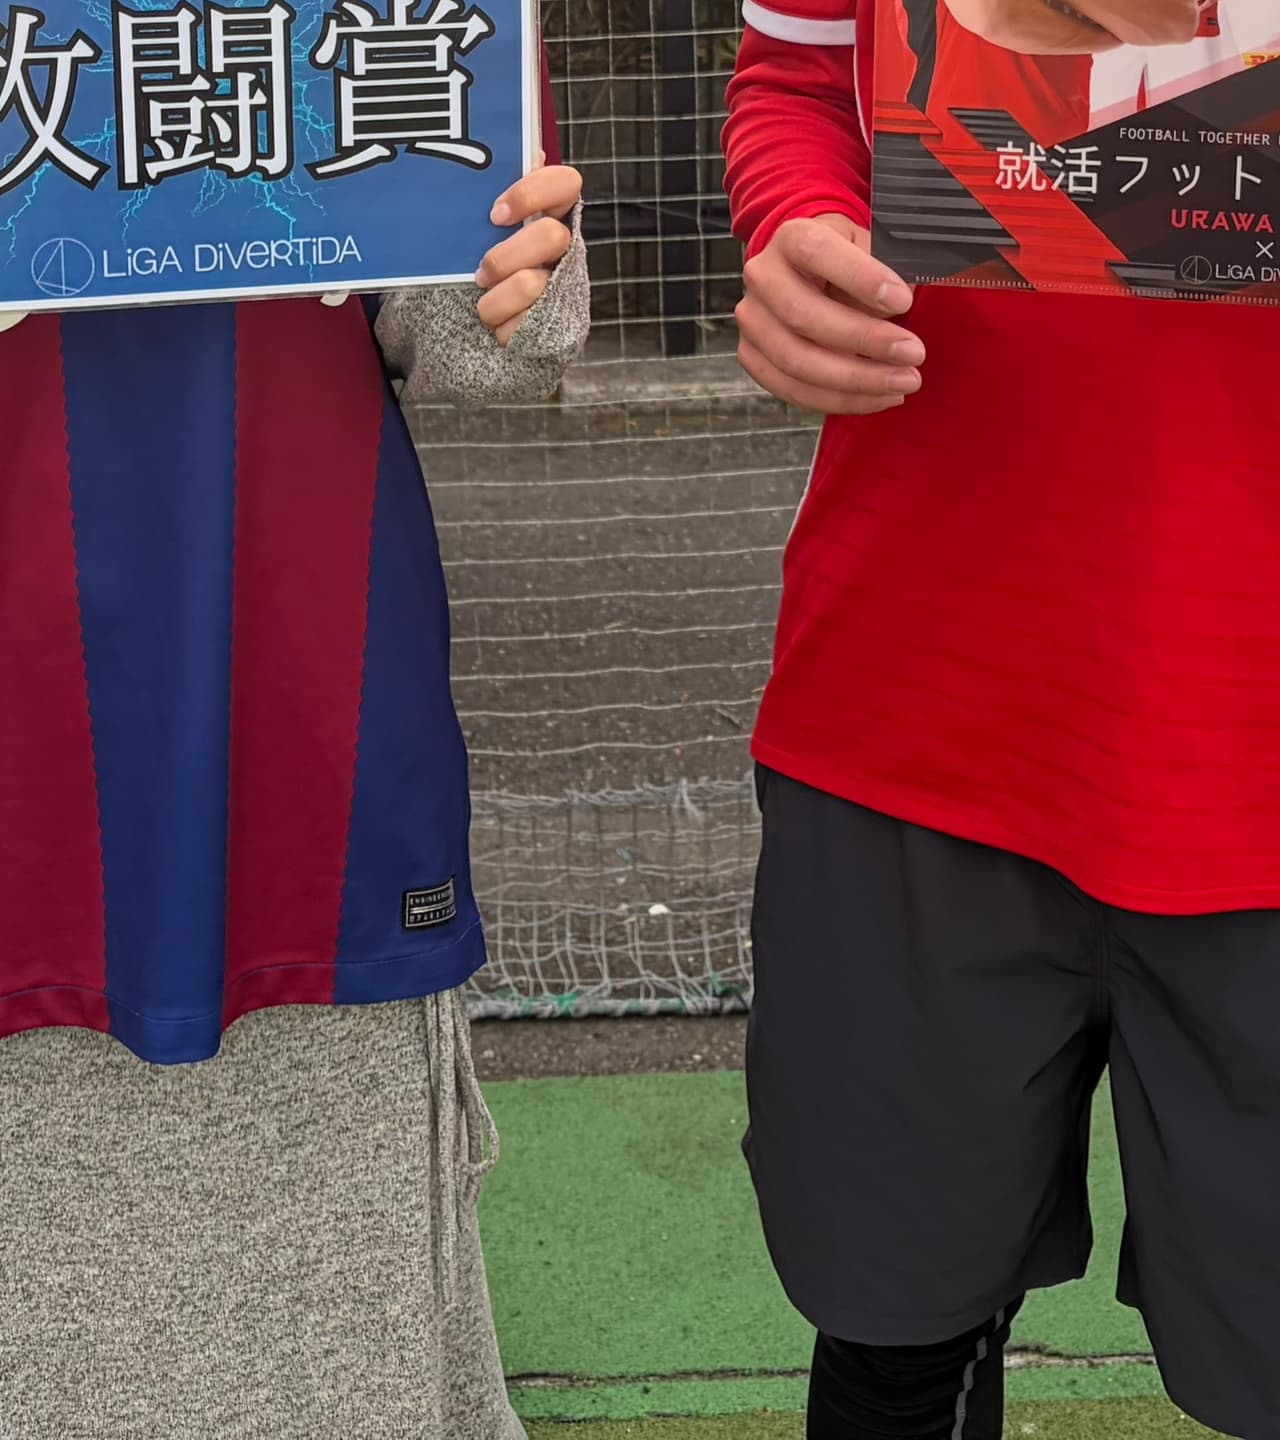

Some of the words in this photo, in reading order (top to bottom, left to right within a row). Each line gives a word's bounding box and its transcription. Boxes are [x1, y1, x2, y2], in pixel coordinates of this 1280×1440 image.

[1120, 127, 1190, 142] FOOTBALL
[1198, 130, 1271, 146] TOGETHER
[1171, 208, 1275, 234] URAWA
